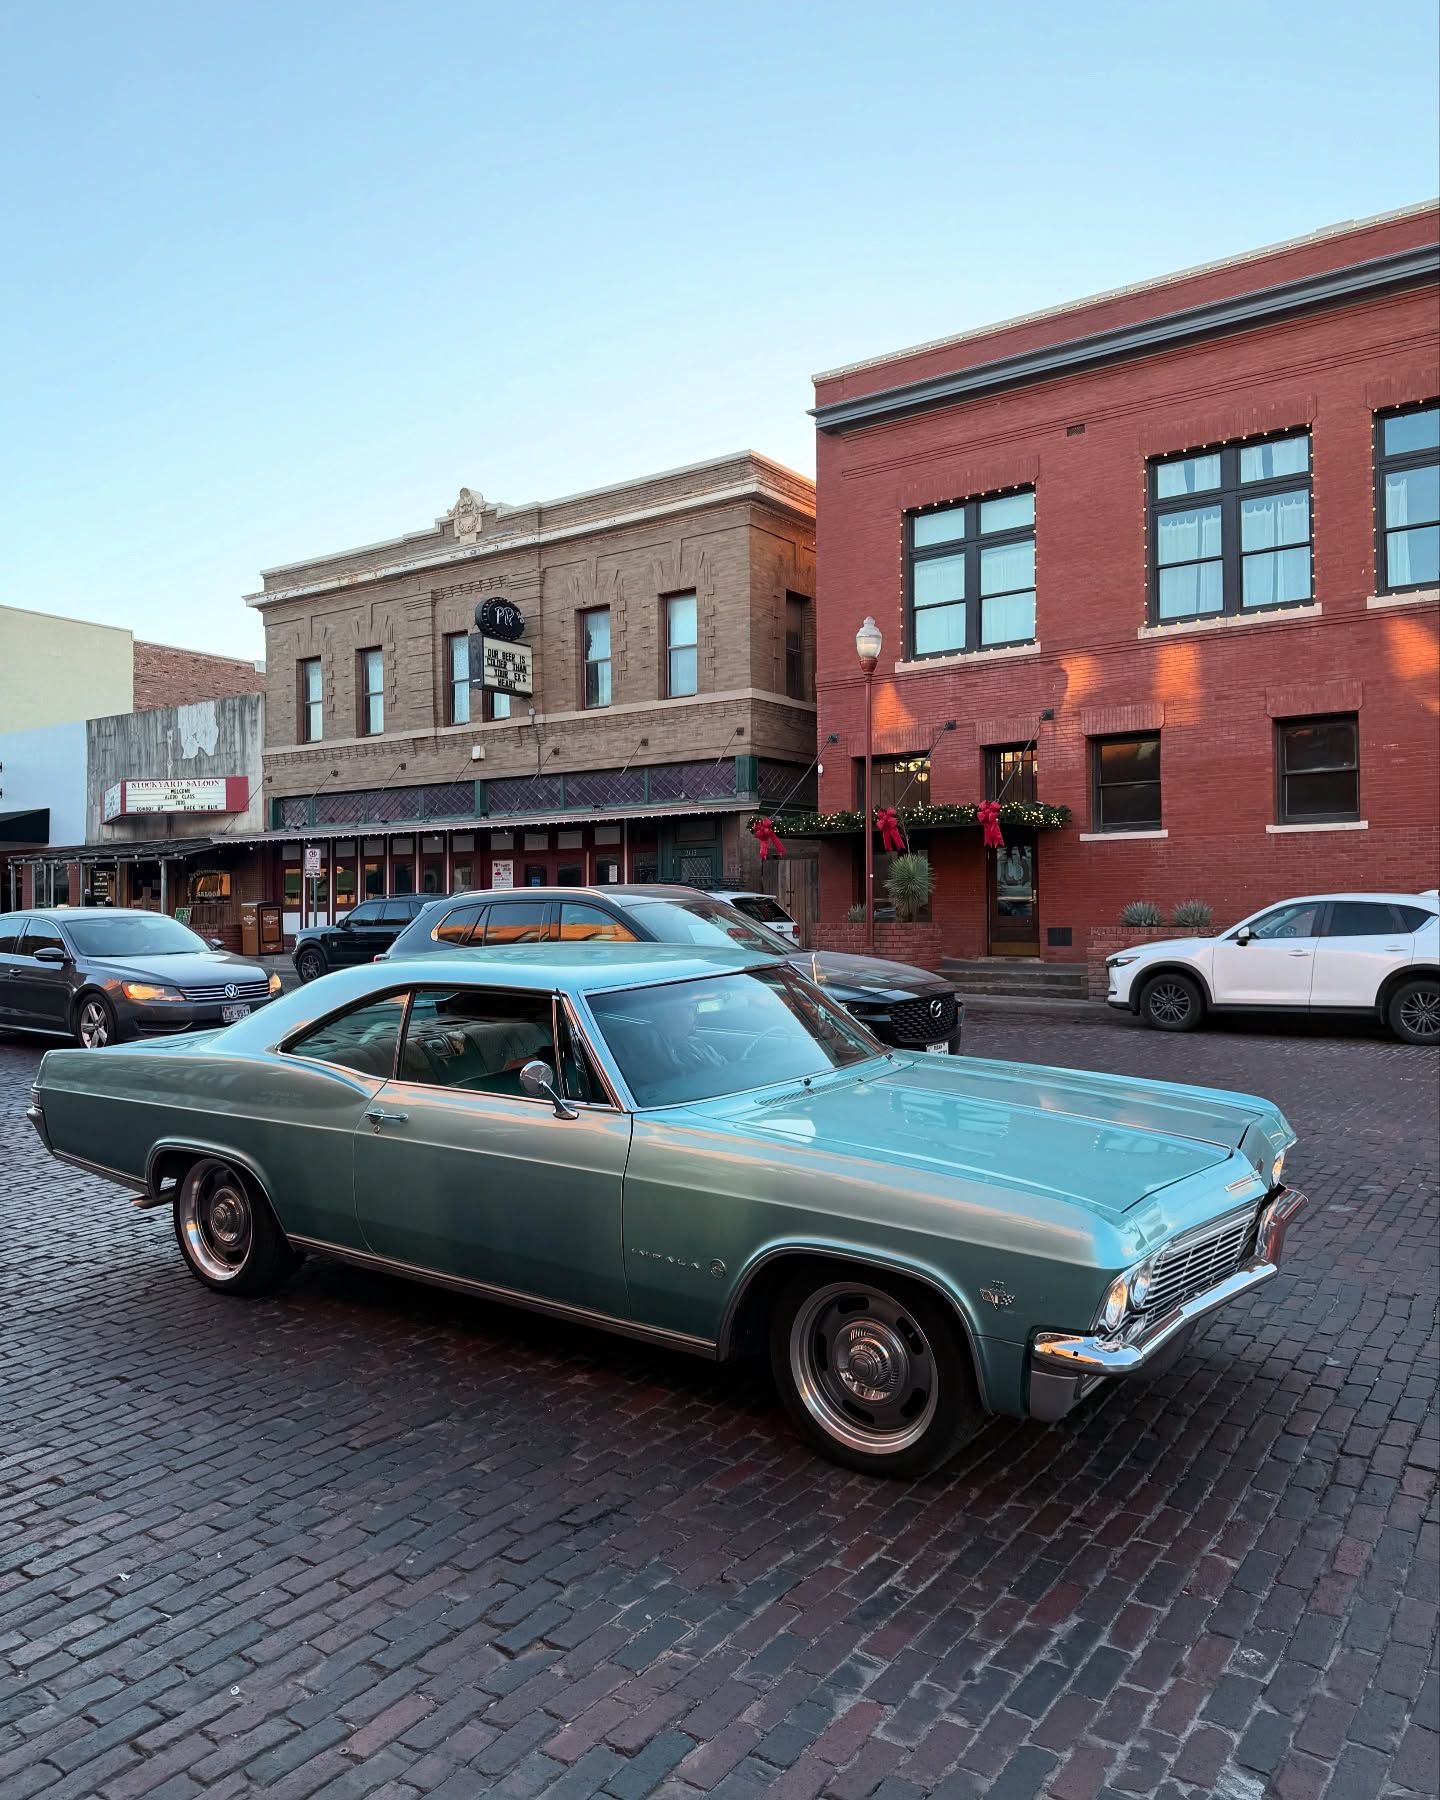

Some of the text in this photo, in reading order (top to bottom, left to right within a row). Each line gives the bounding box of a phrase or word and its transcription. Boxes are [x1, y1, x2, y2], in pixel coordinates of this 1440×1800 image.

[488, 649, 526, 664] OUR BEER IS
[487, 658, 527, 674] COLDER THAN
[494, 668, 508, 679] YOUR
[498, 678, 516, 689] HEART
[131, 780, 182, 789] STOCKYARD
